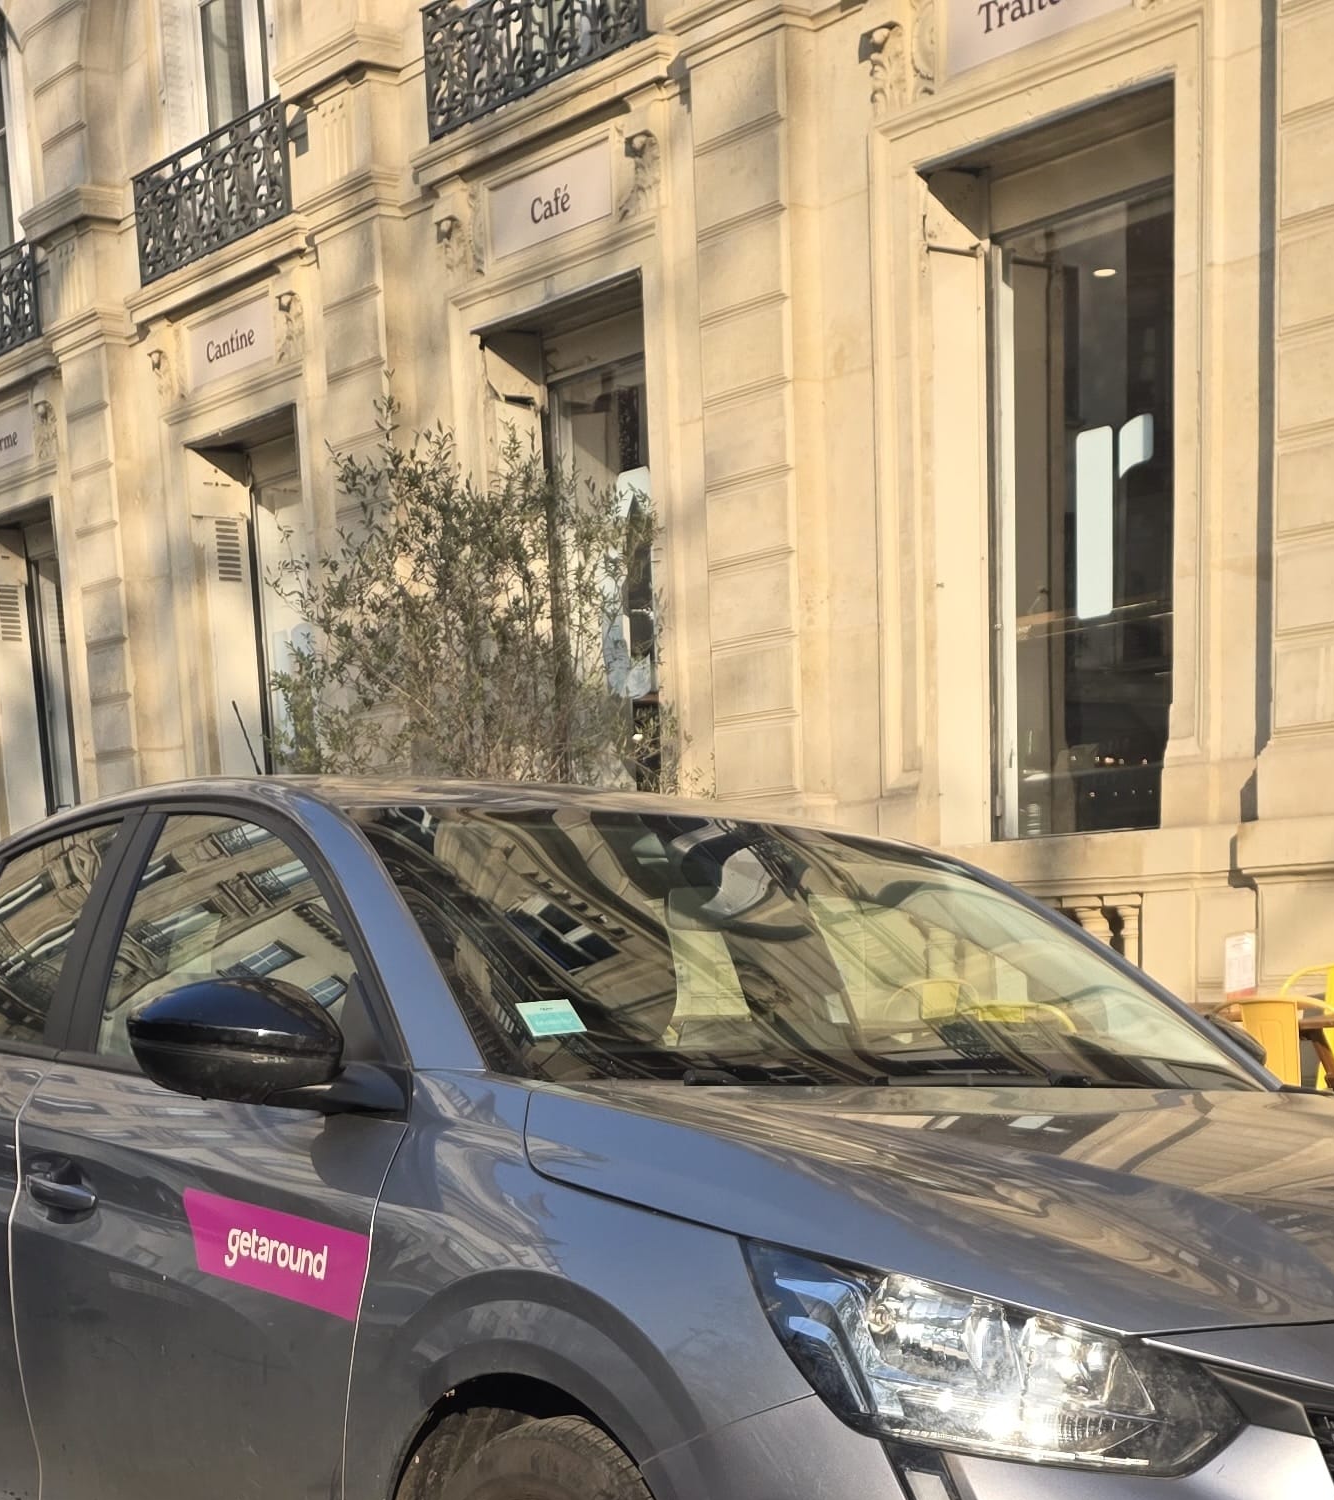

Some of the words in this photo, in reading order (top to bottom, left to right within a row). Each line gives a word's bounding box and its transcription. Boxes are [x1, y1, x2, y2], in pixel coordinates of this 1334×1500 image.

[530, 183, 571, 225] Café
[206, 327, 256, 363] Cantine
[224, 1227, 328, 1281] getaround
